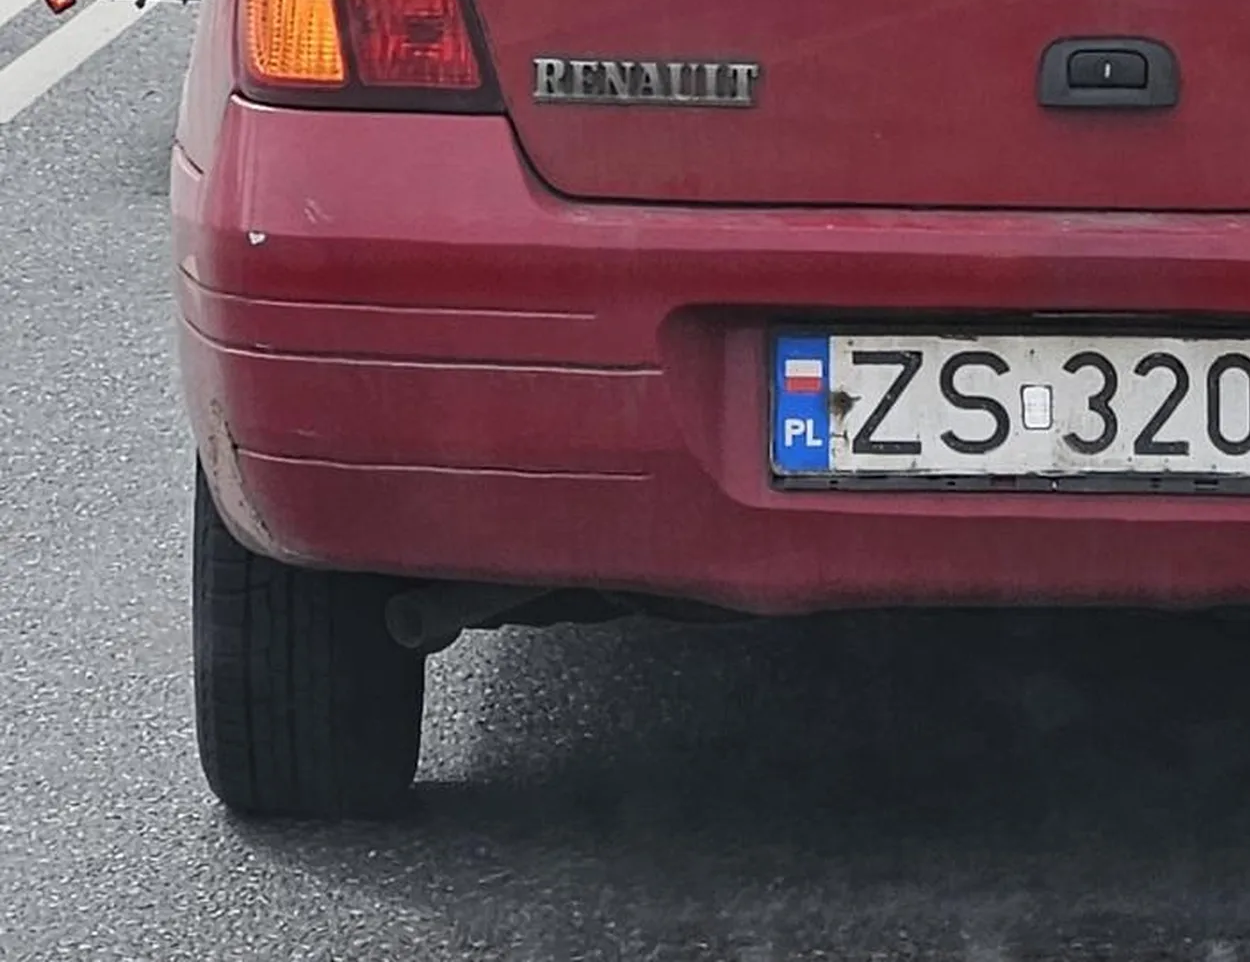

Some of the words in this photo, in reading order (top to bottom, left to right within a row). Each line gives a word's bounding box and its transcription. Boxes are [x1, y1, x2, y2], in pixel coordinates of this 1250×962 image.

[533, 58, 759, 103] RENAULT
[852, 350, 1011, 455] ZS
[784, 418, 823, 448] PL
